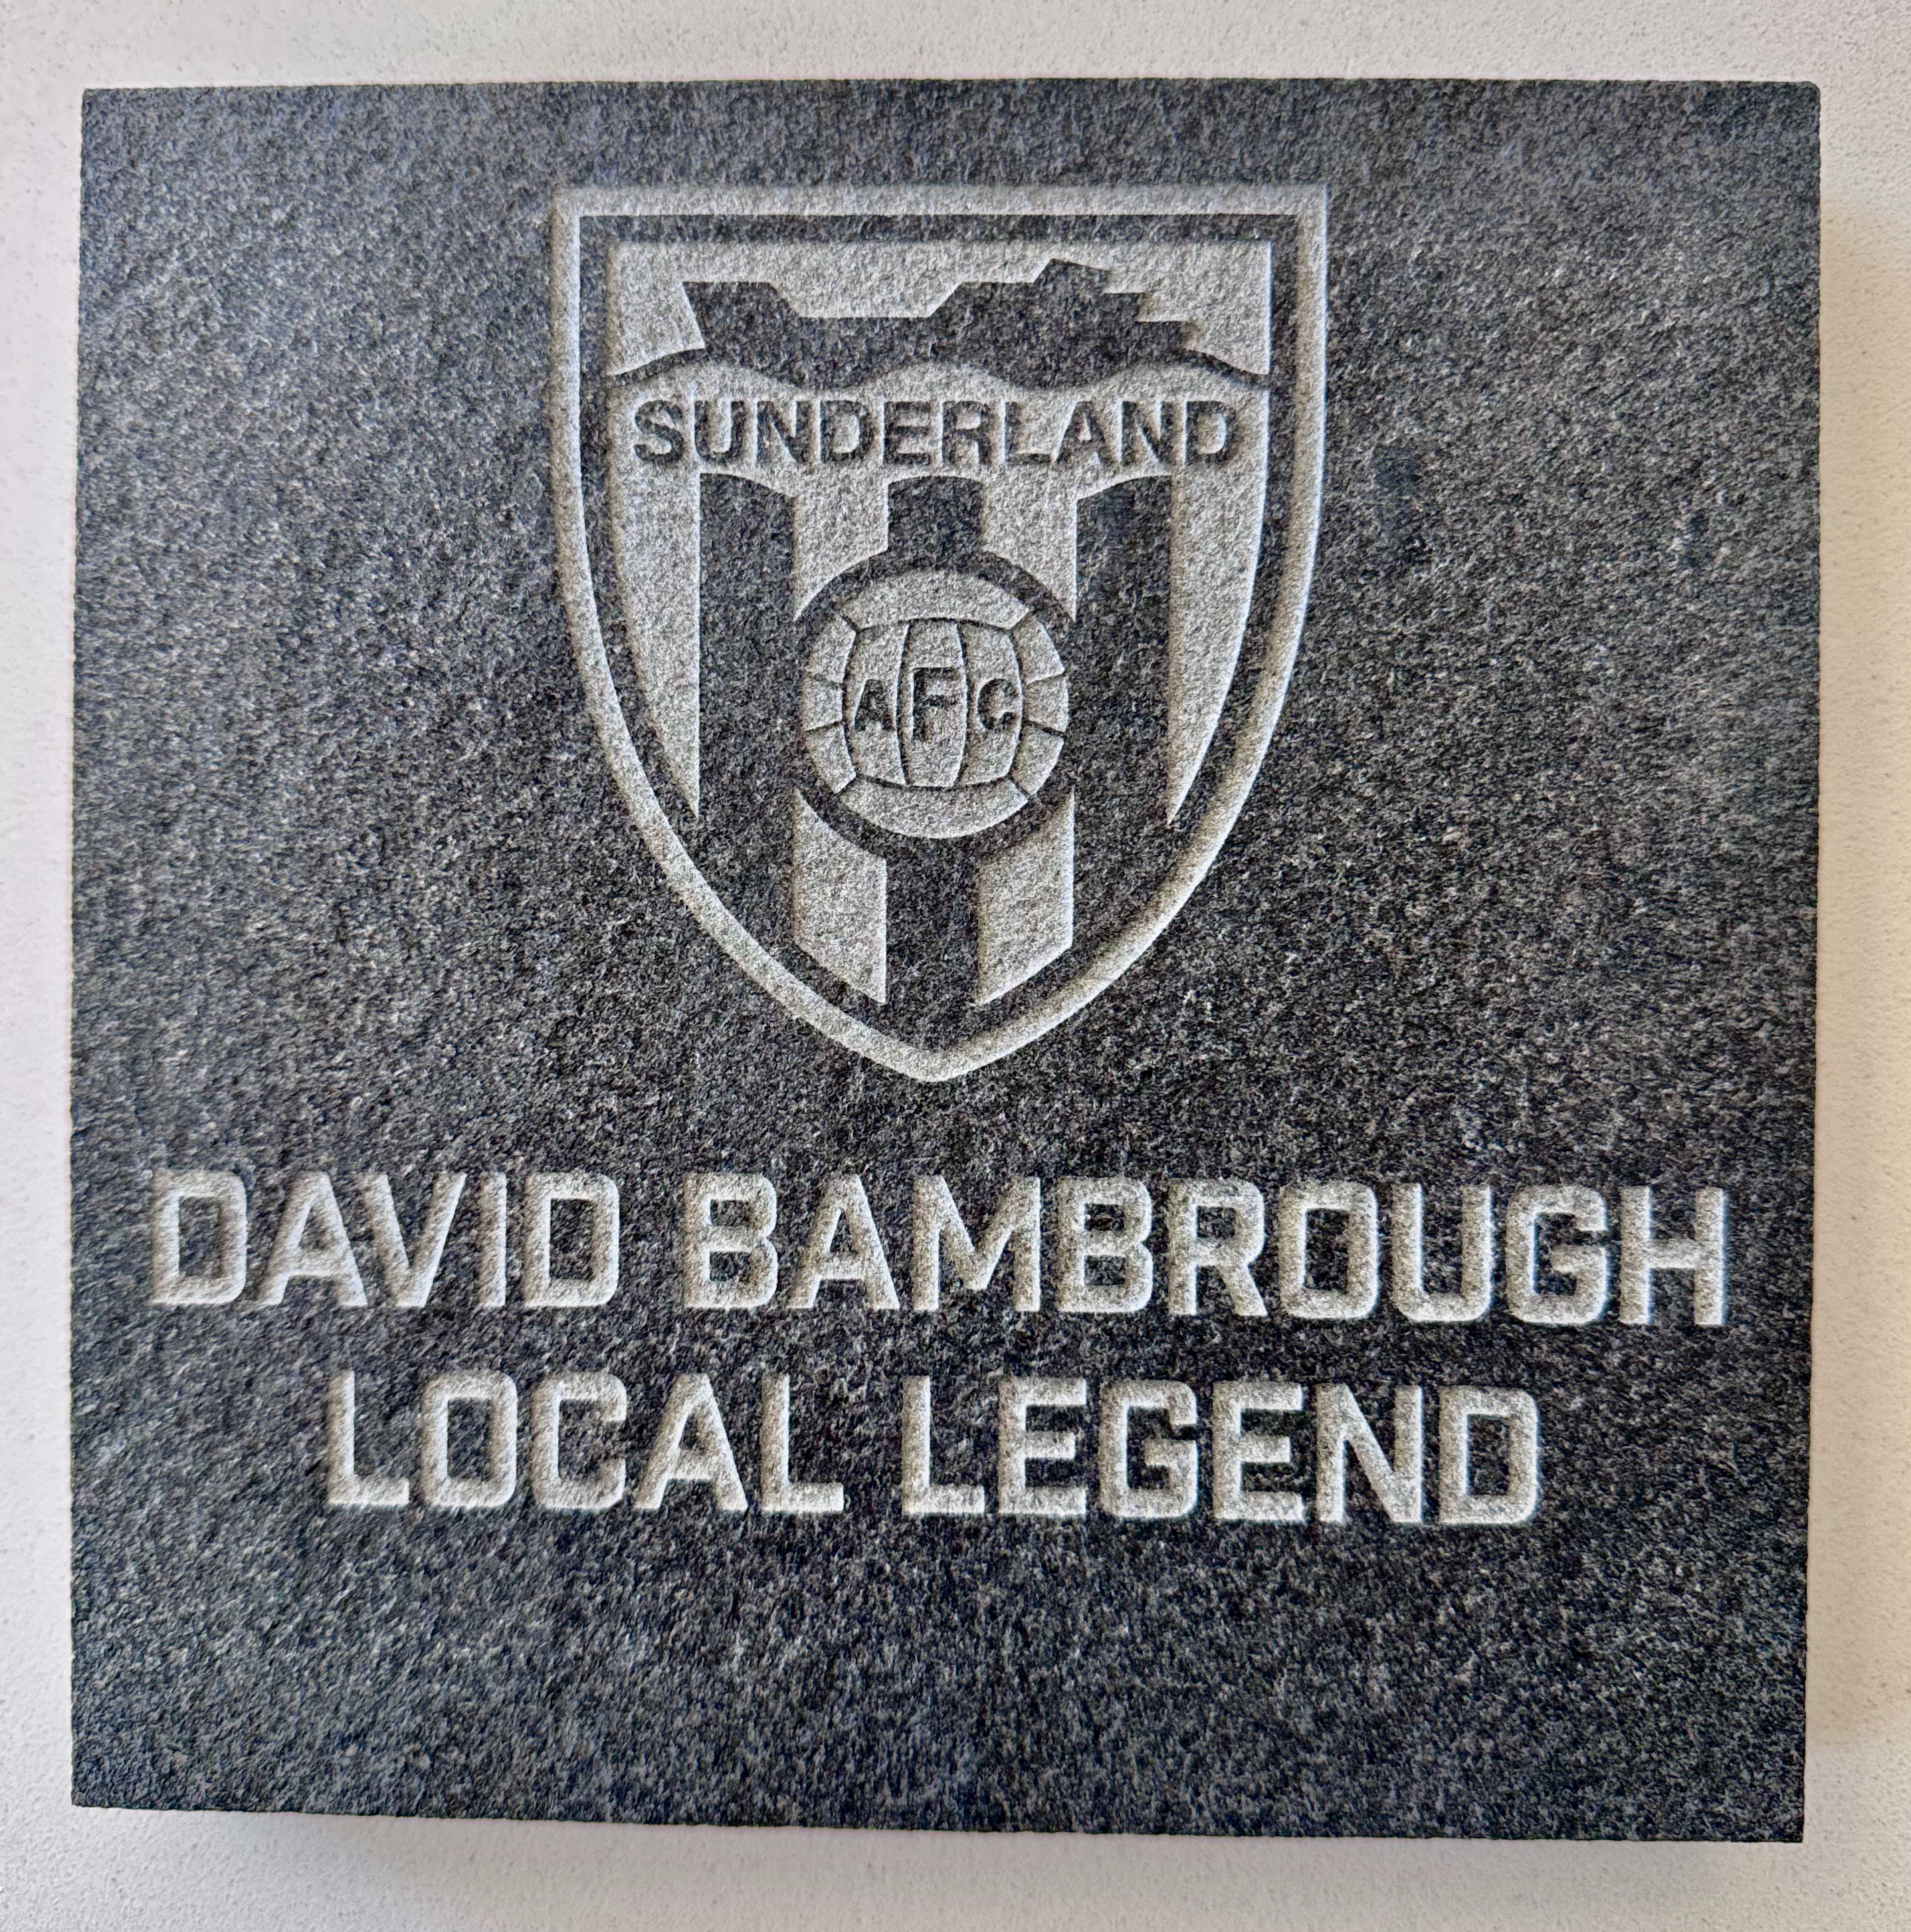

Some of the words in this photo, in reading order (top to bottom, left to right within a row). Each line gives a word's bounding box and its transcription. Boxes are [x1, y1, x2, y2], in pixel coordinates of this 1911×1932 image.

[633, 399, 1237, 466] SUNDERLAND
[150, 1170, 621, 1308] DAVID
[682, 1171, 1727, 1328] BAMBROUGH
[326, 1369, 847, 1513] LOCAL
[900, 1374, 1540, 1526] LEGEND
